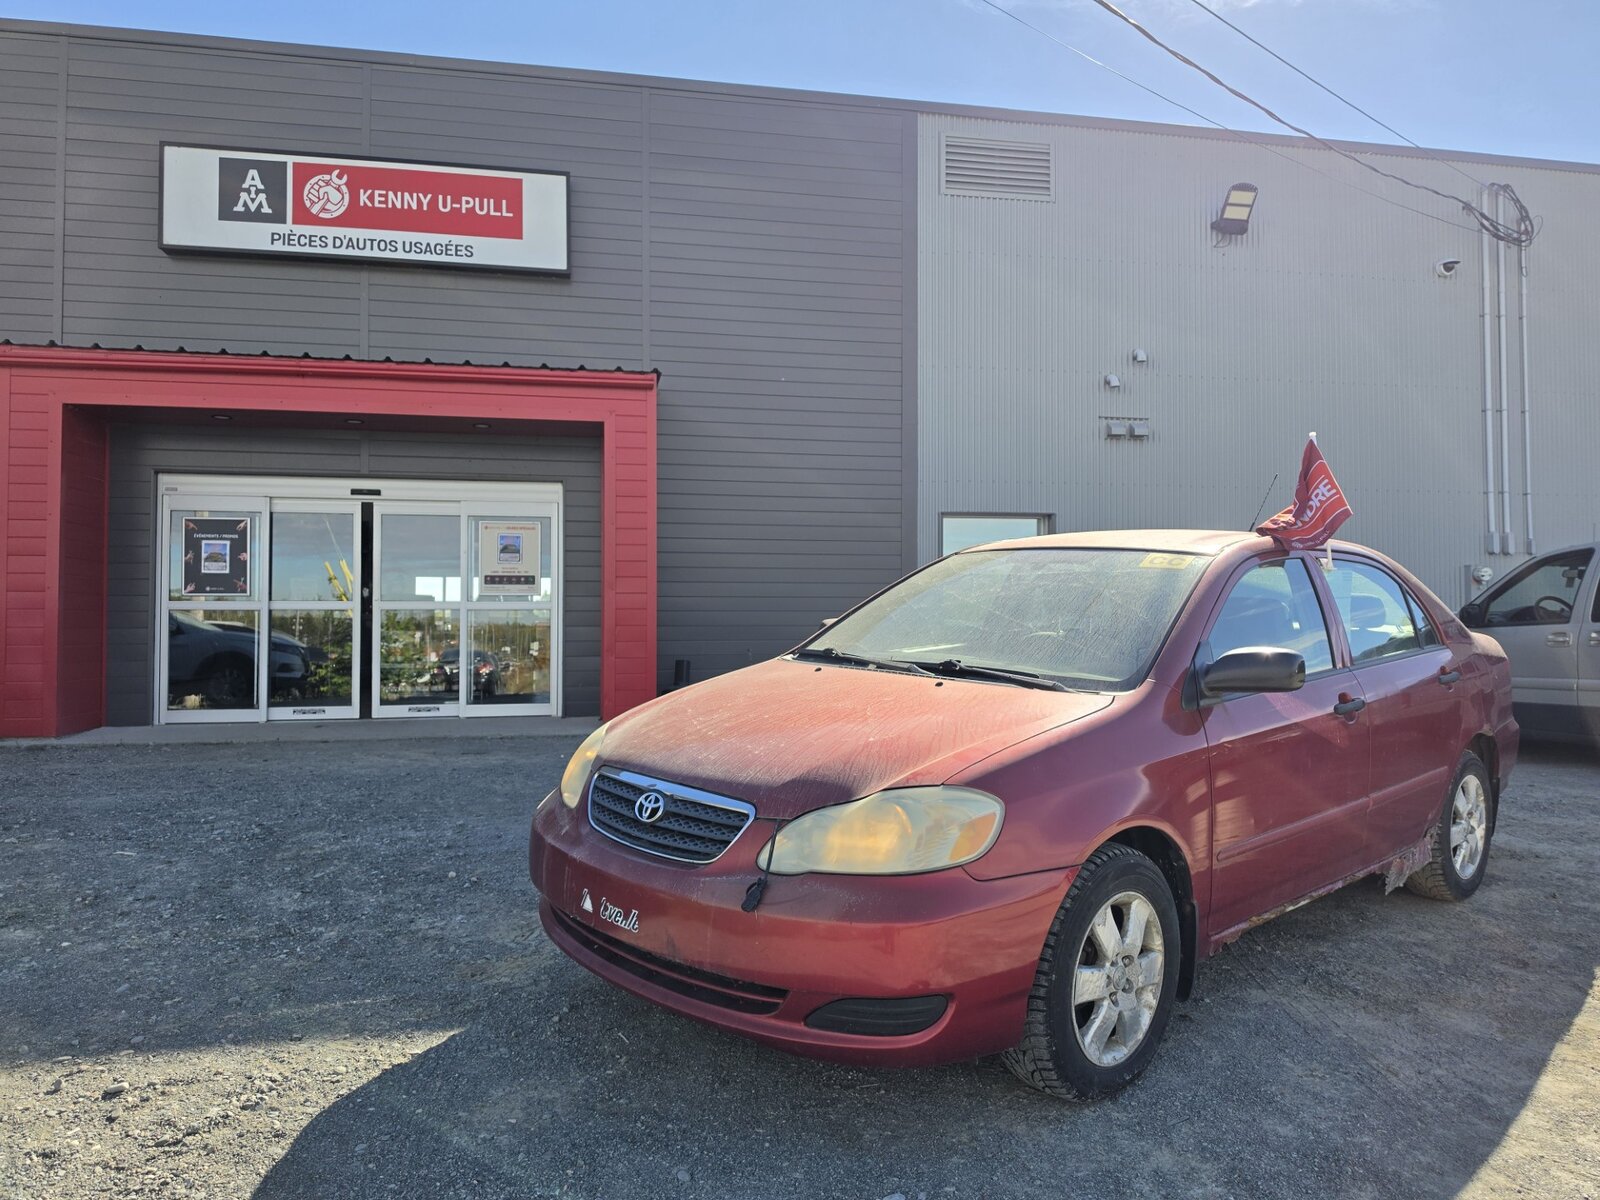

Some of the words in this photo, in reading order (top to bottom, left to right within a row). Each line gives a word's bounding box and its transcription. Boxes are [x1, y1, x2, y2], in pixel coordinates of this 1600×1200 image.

[359, 188, 432, 212] KENNY
[438, 194, 514, 217] U-PULL
[270, 229, 329, 249] PIÈCES
[332, 235, 398, 254] D'AUTOS
[402, 238, 474, 258] USAGÉES
